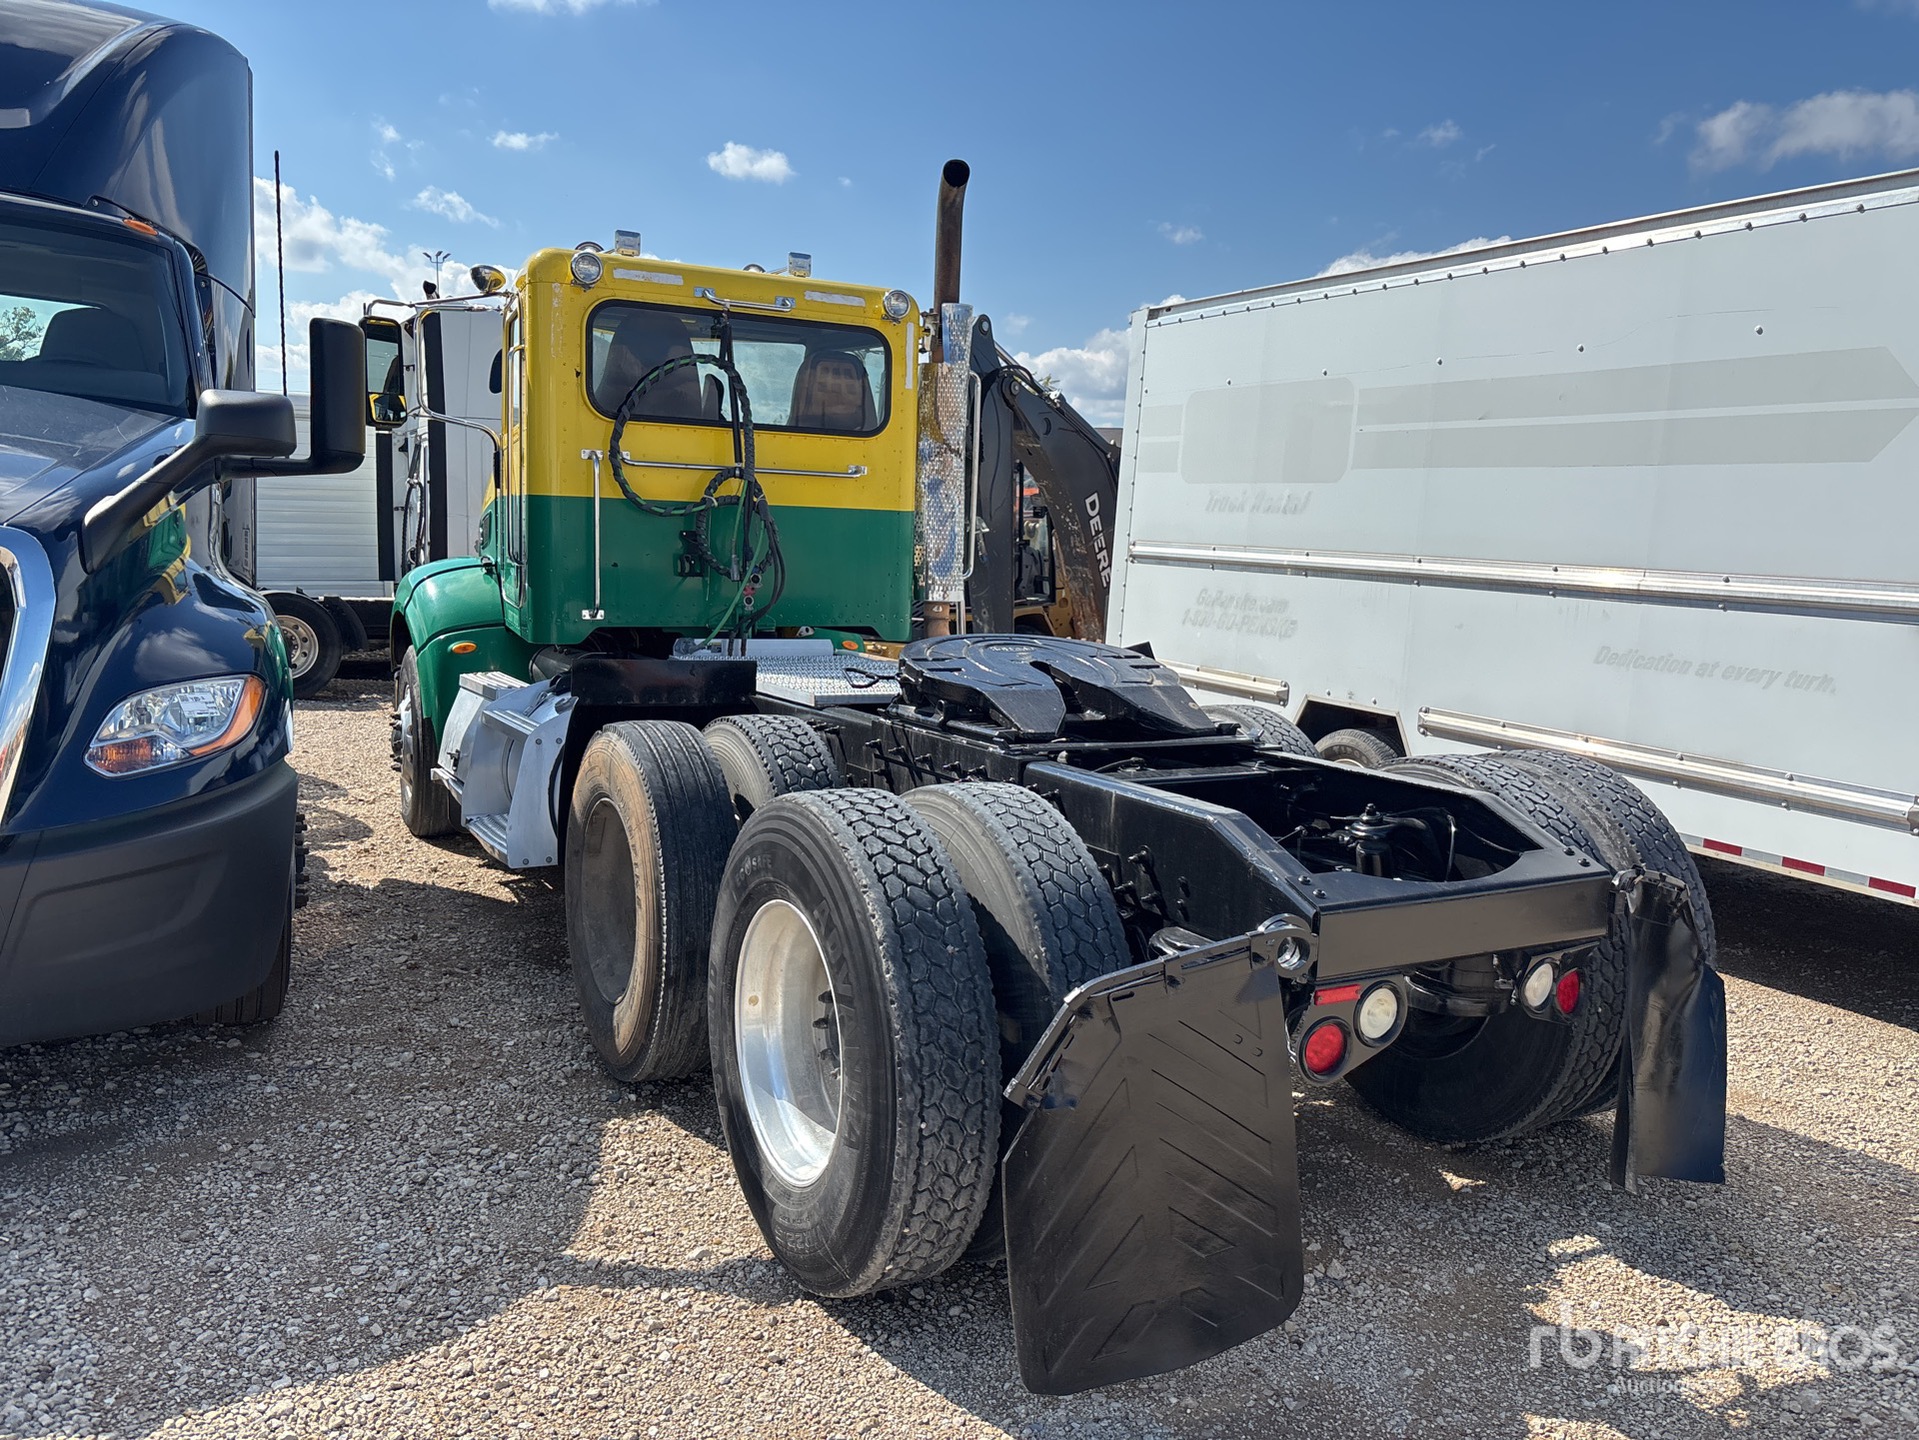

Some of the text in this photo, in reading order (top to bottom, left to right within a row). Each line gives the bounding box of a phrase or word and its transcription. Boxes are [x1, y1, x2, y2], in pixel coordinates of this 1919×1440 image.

[1085, 492, 1111, 588] DEERE
[1593, 645, 1693, 674] Dedication
[1694, 660, 1721, 678] at
[1721, 664, 1783, 690] every
